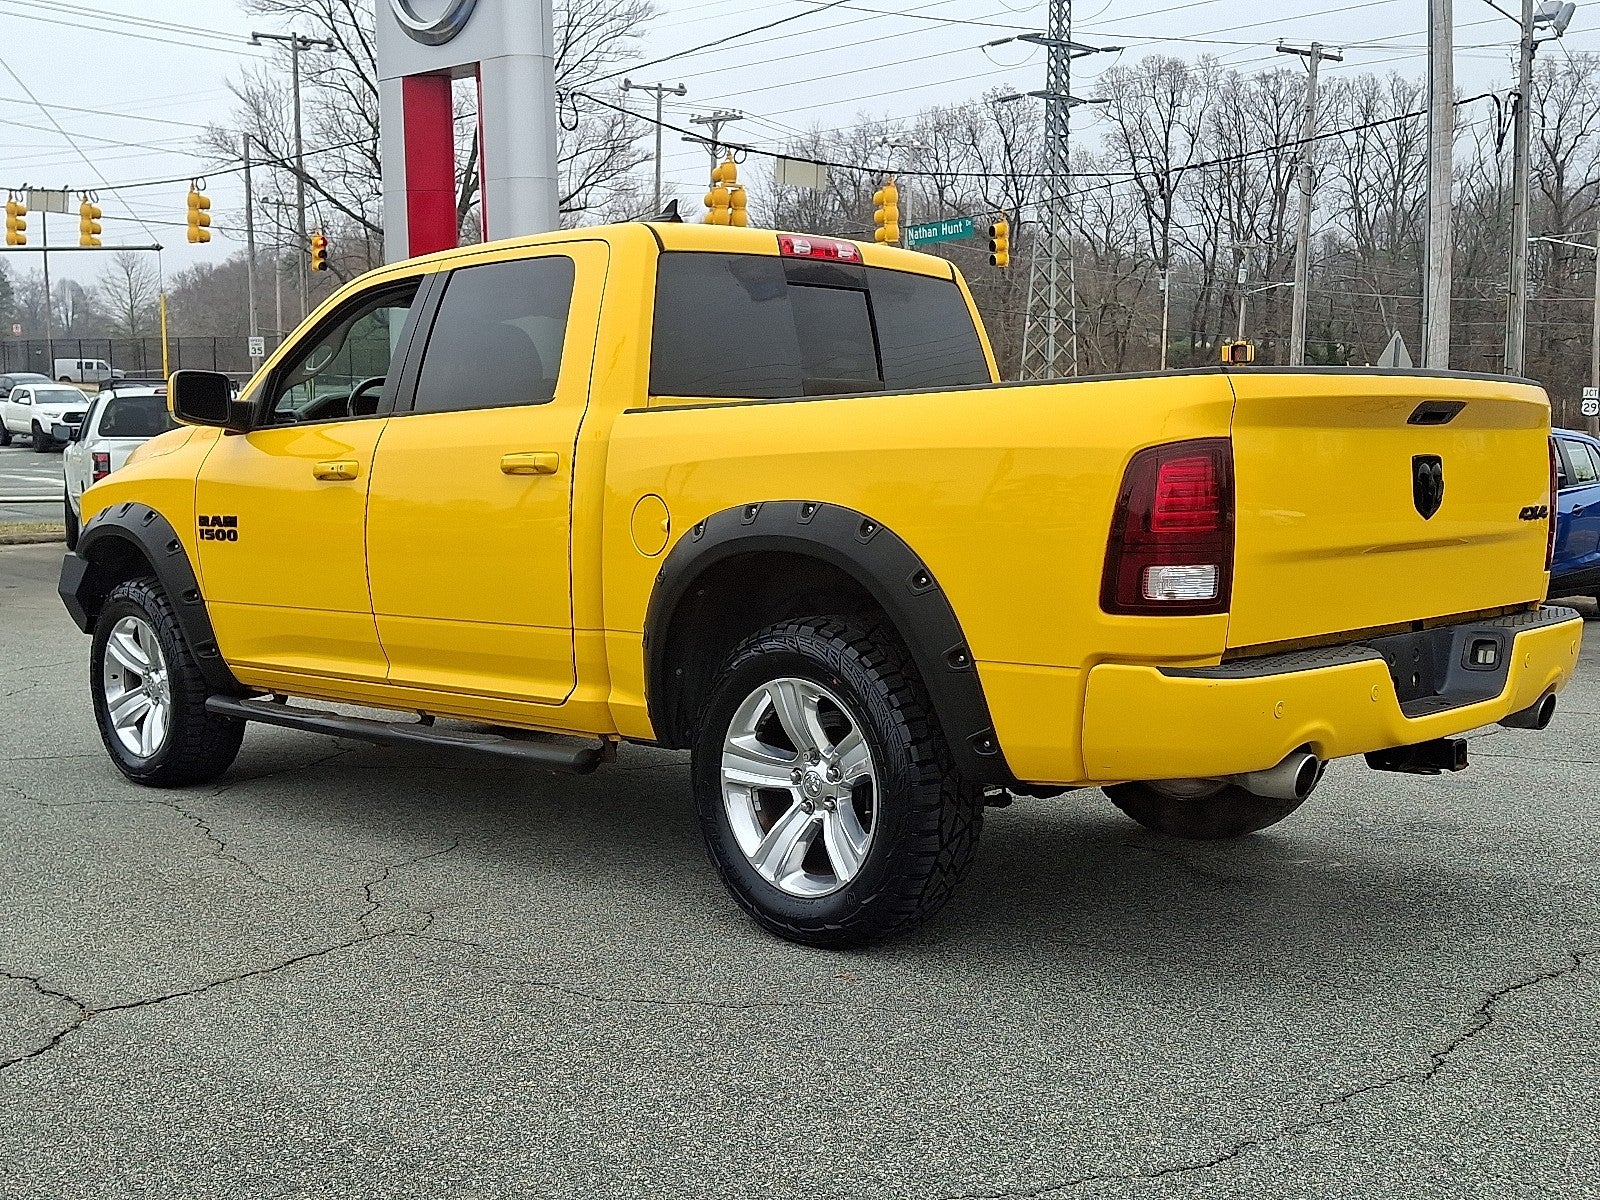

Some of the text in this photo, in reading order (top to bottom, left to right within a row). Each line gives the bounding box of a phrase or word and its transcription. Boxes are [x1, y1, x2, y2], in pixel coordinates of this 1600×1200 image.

[908, 219, 972, 240] Nathan Hunt Dr
[251, 346, 263, 355] 35
[1584, 389, 1598, 397] JCT
[1583, 402, 1597, 412] 29
[198, 515, 238, 528] RAM
[198, 528, 239, 542] 1500
